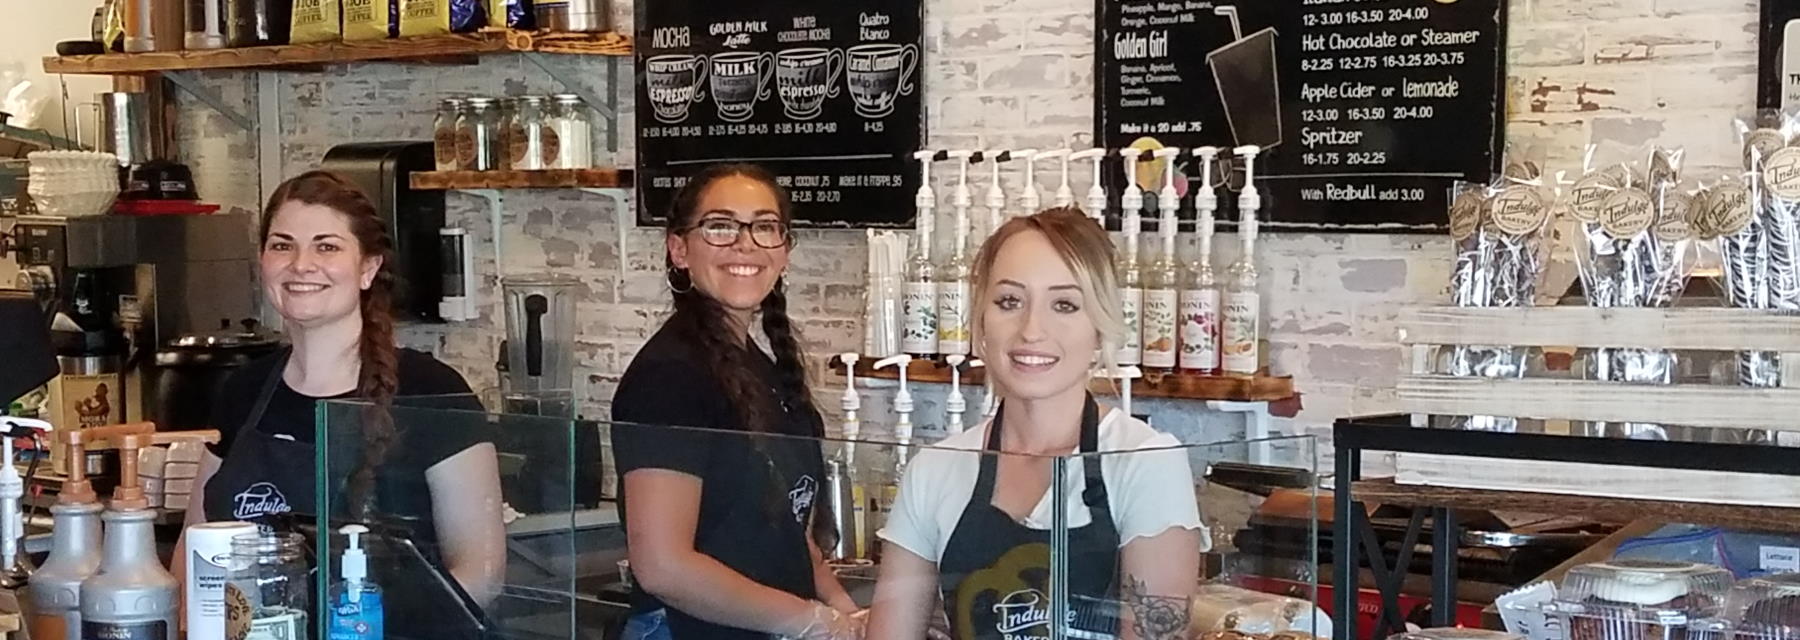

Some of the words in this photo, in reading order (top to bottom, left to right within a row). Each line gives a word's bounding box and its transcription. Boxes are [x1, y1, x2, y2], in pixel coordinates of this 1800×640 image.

[860, 11, 890, 26] Quatro
[1149, 15, 1179, 25] Coconut
[1180, 13, 1195, 23] Milk
[1320, 13, 1343, 25] 3.00
[1345, 10, 1384, 23] 16-3.50
[1388, 7, 1429, 21] 20-4.00
[709, 22, 741, 36] GOLDEN
[744, 21, 768, 33] MILK
[860, 26, 890, 41] Blanco
[722, 33, 752, 48] Latte
[1114, 32, 1148, 60] Golden
[1149, 30, 1168, 58] Girl
[1303, 34, 1325, 51] Hot
[1329, 31, 1397, 50] Chocolate
[1401, 35, 1418, 46] or
[1421, 28, 1480, 46] Steamer
[714, 61, 756, 76] MILK
[1301, 58, 1334, 71] 8-2.25
[1339, 56, 1377, 69] 12-2.75
[1382, 54, 1422, 67] 16-3.25
[1423, 52, 1465, 66] 20-3.75
[650, 86, 693, 104] ESPRESSO
[780, 84, 826, 100] espresso
[1301, 83, 1338, 102] Apple
[1340, 82, 1376, 99] Cider
[1381, 86, 1396, 97] or
[1403, 75, 1459, 98] lemonade
[1121, 98, 1149, 107] Coconut
[1150, 96, 1165, 106] Milk
[1302, 109, 1339, 121] 12-3.00
[1347, 107, 1386, 120] 16-3.50
[1393, 106, 1433, 119] 20-4.00
[1121, 123, 1141, 133] Make
[1143, 123, 1149, 132] it
[1150, 125, 1156, 133] a
[1157, 122, 1169, 132] 20
[1171, 121, 1186, 132] add
[1188, 121, 1202, 132] .75
[1301, 127, 1363, 149] Spritzer
[1302, 153, 1339, 165] 16-1.75
[1346, 152, 1386, 165] 20-2.25
[1767, 158, 1800, 184] Indu
[1301, 188, 1324, 200] With
[1326, 183, 1376, 200] Redbull
[1379, 189, 1399, 200] add
[1401, 188, 1425, 200] 3.00
[1497, 195, 1543, 216] Indulge
[1603, 196, 1648, 224] Indulge
[1708, 192, 1747, 226] Indulge
[993, 593, 1077, 633] Indule
